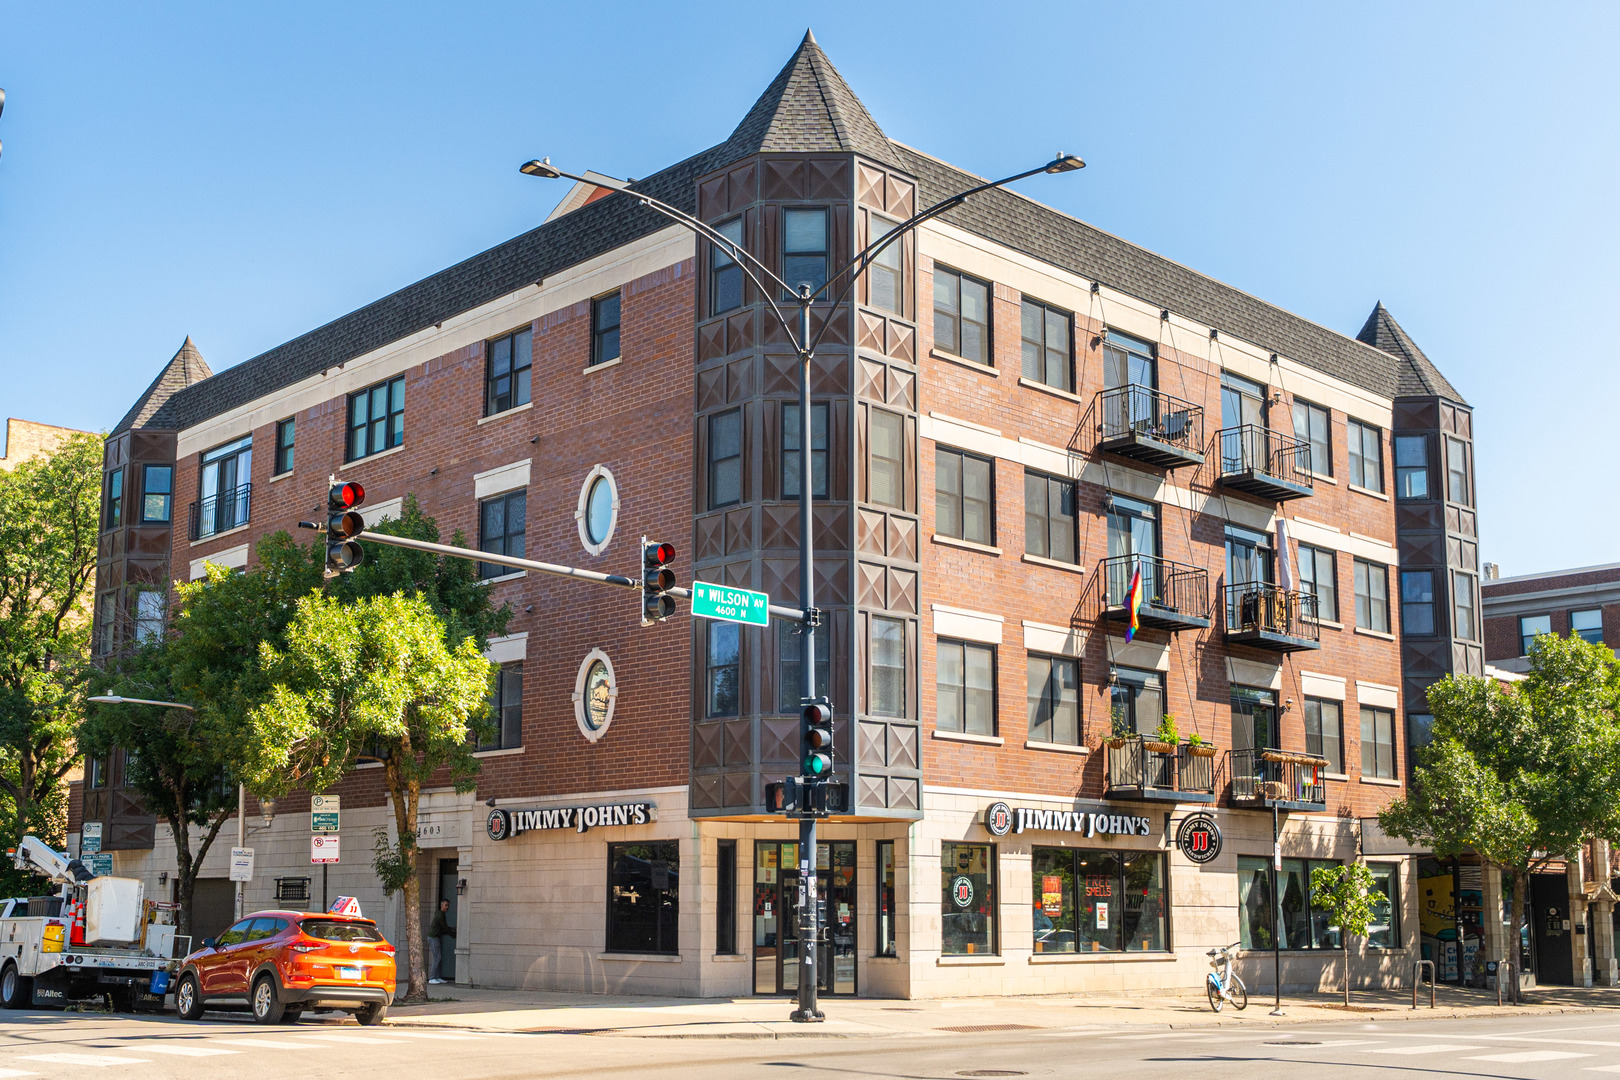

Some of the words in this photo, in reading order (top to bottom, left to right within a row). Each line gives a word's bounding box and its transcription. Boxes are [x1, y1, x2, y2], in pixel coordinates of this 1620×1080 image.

[697, 588, 705, 598] W
[709, 588, 749, 608] WILSON
[753, 598, 764, 608] AV
[715, 605, 736, 616] 4600
[740, 609, 747, 618] N
[510, 808, 573, 837] JIMMY
[577, 803, 646, 833] JOHN'S
[1016, 808, 1085, 834] JIMMY
[1087, 813, 1150, 838] JOHN'S
[1184, 821, 1199, 841] JIMMY
[1200, 821, 1217, 841] JOHN'S
[1192, 831, 1209, 851] JJ
[1085, 874, 1112, 888] FREE
[958, 885, 968, 900] JJ
[1085, 887, 1112, 897] SMELLS
[44, 989, 63, 998] Altec
